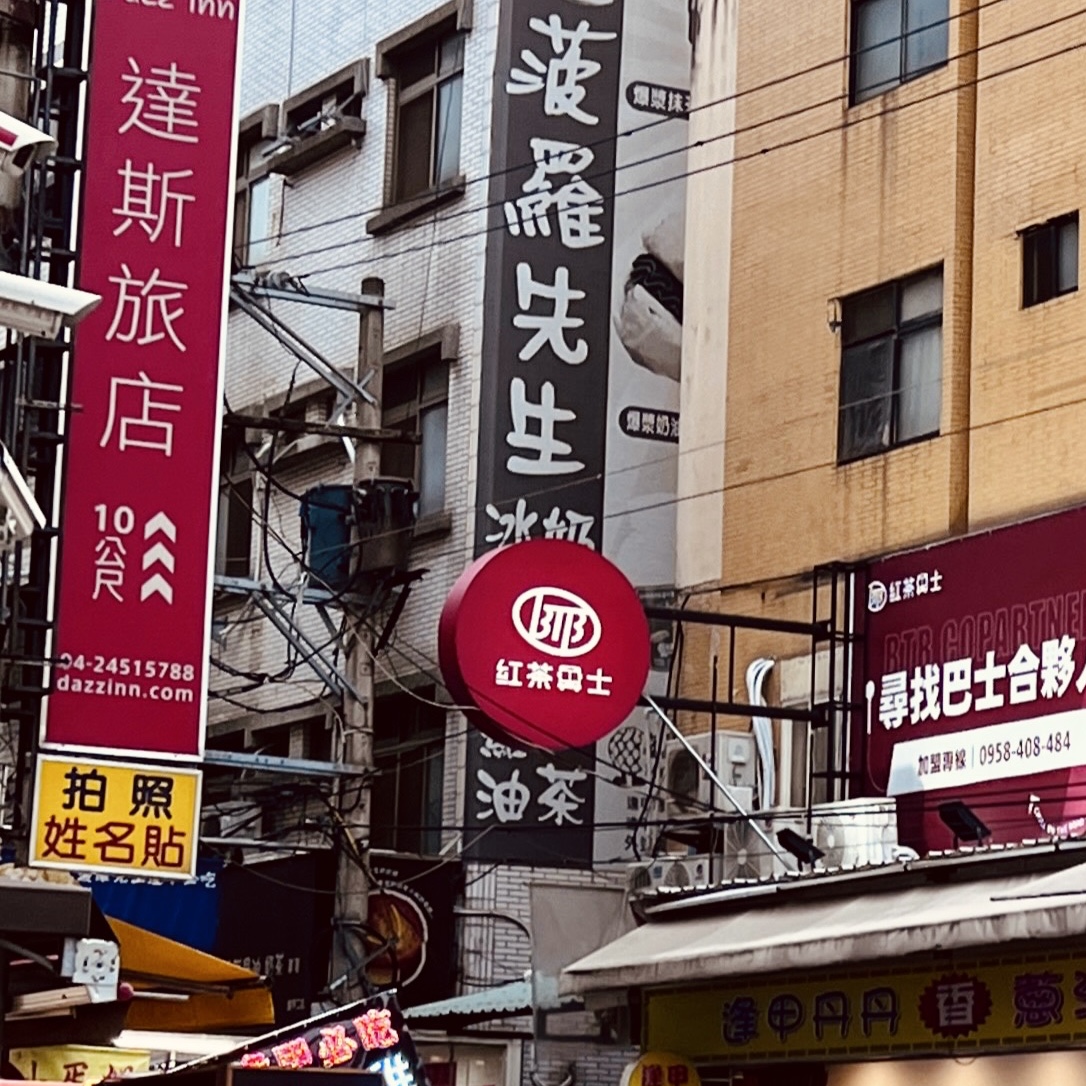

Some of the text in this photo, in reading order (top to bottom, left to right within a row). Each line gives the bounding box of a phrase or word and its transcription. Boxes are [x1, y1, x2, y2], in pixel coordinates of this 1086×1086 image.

[98, 55, 201, 458] 達斯旅店
[94, 503, 135, 535] 10
[92, 535, 126, 602] 公尺
[58, 652, 195, 682] 04-24515788
[494, 657, 614, 698] 紅茶巴士
[56, 673, 194, 703] dazzinn.com
[978, 730, 1072, 766] 0958-408-484
[61, 766, 174, 820] 拍照
[41, 814, 187, 869] 姓名貼
